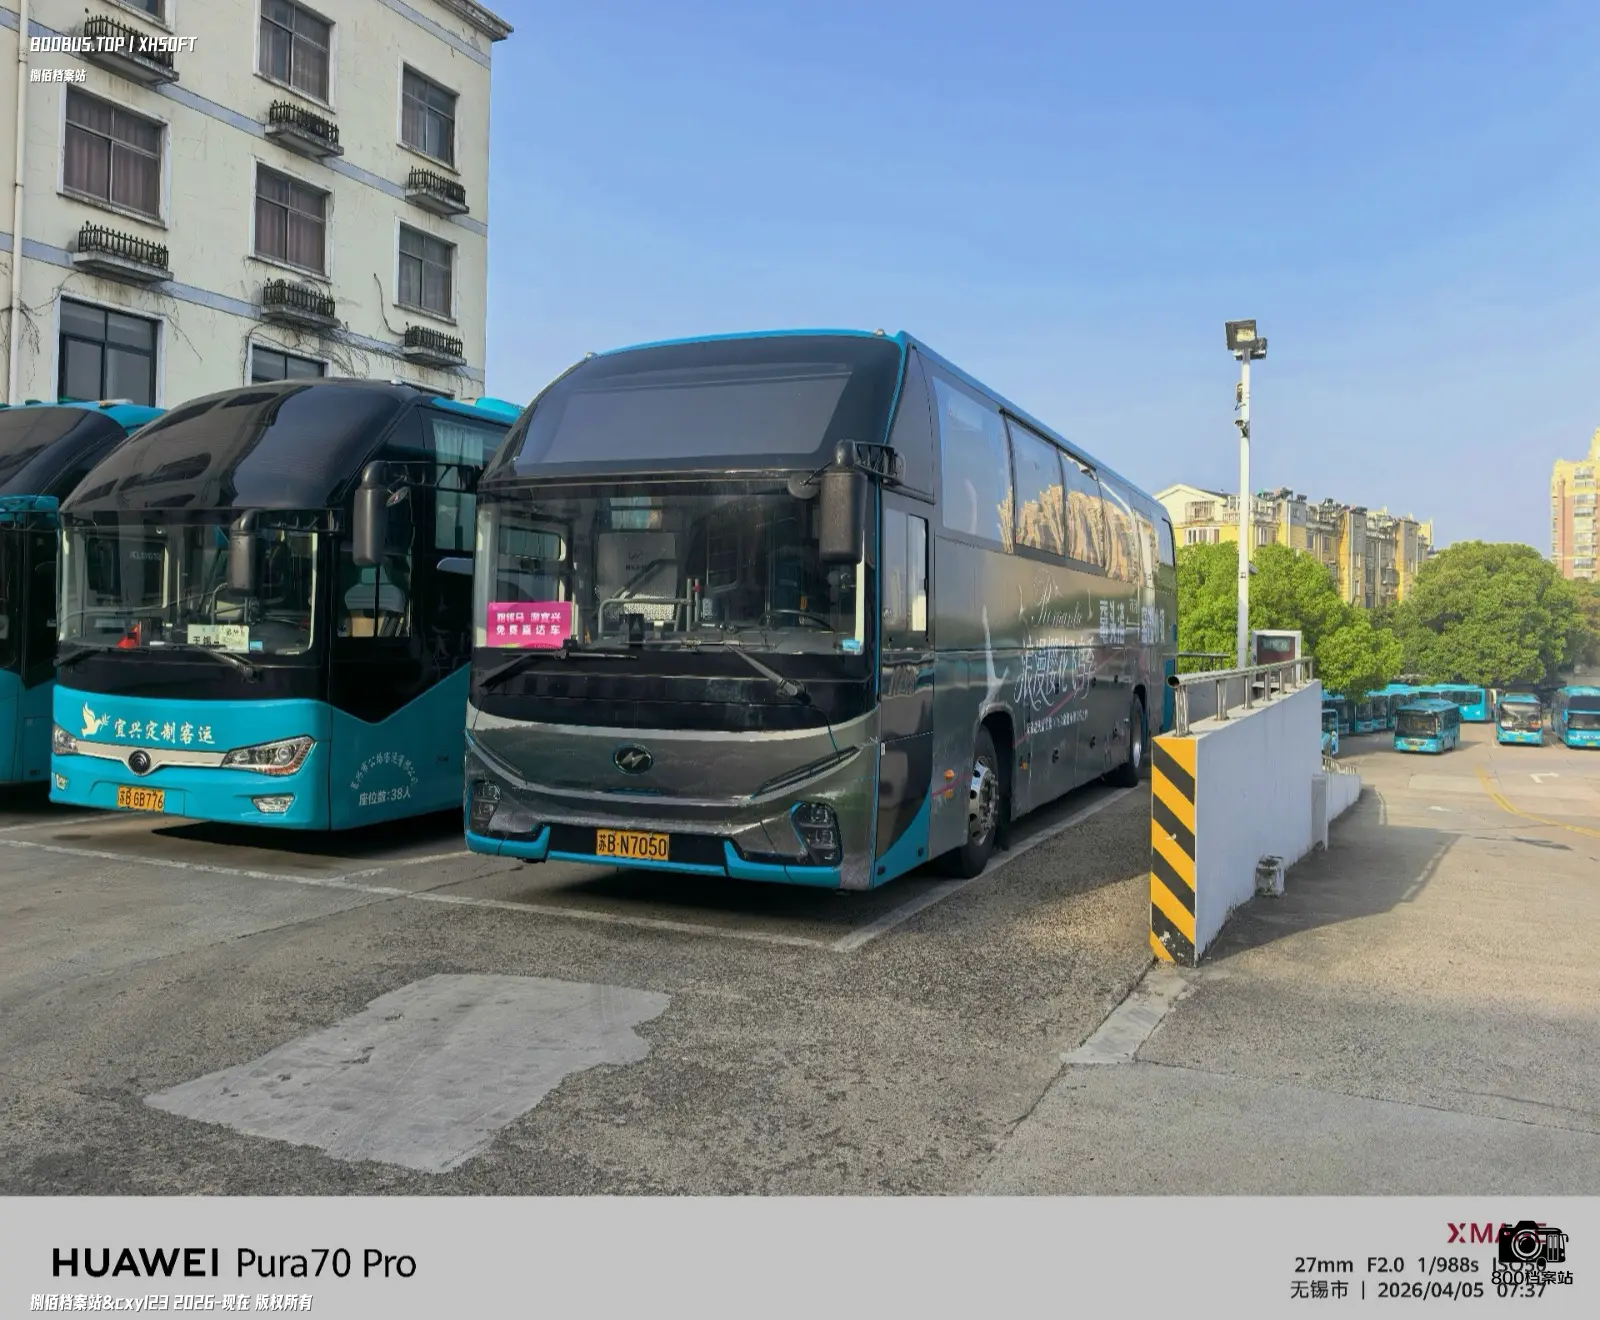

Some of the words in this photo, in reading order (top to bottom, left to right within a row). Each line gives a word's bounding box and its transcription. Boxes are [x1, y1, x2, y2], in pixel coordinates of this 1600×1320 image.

[114, 718, 216, 745] 宜兴定制客运
